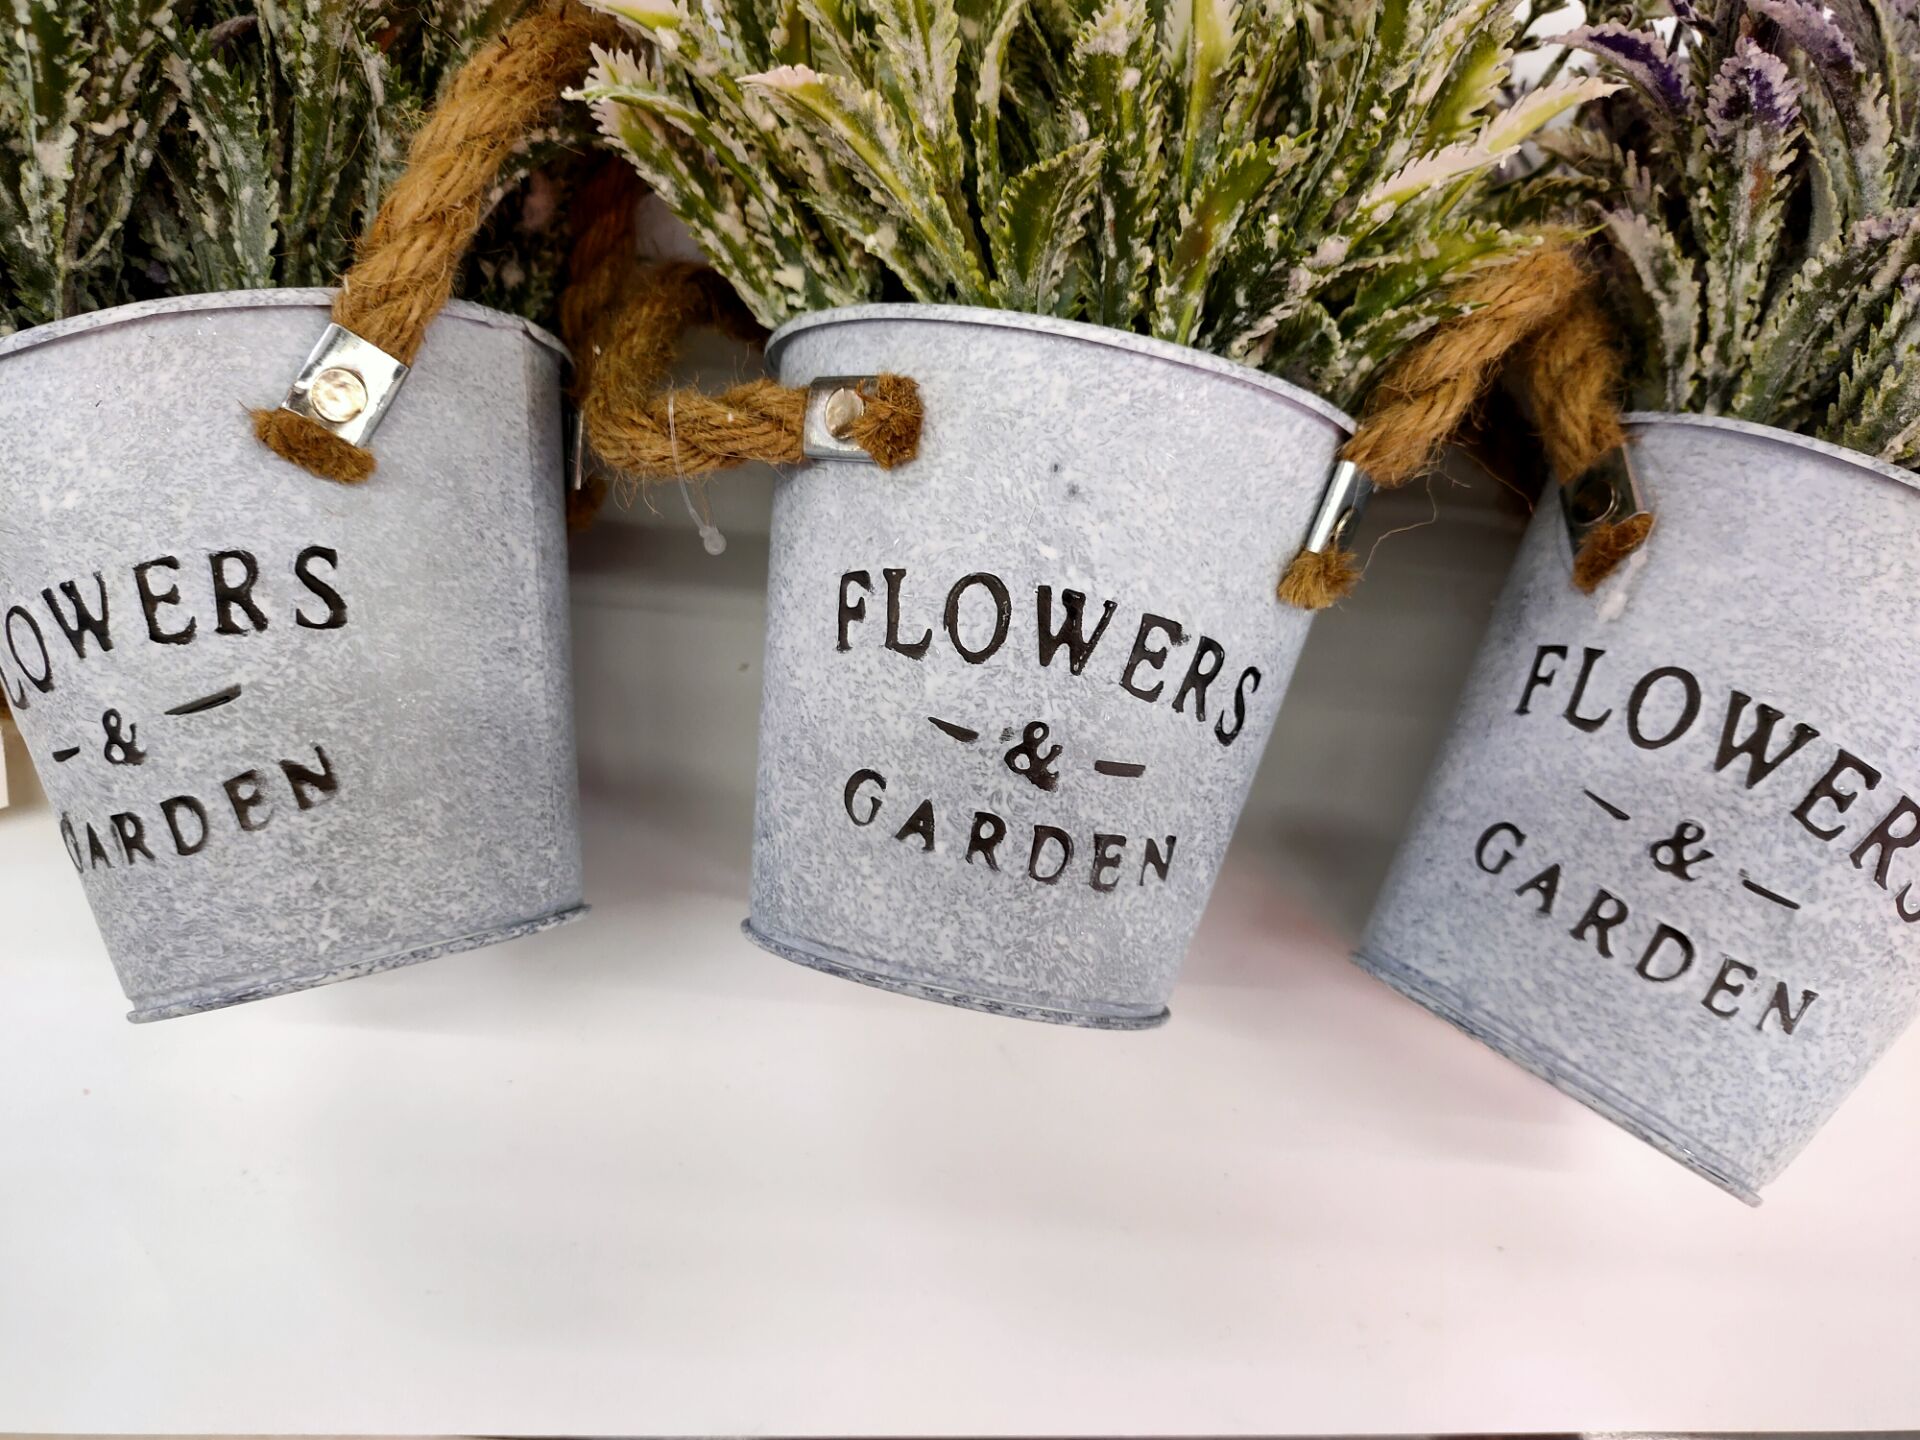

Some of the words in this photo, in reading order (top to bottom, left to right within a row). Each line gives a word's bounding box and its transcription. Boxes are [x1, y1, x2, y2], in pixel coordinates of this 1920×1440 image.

[836, 568, 1262, 747] FLOWERS
[844, 768, 1178, 892] GARDEN
[1475, 822, 1820, 1035] GARDEN
